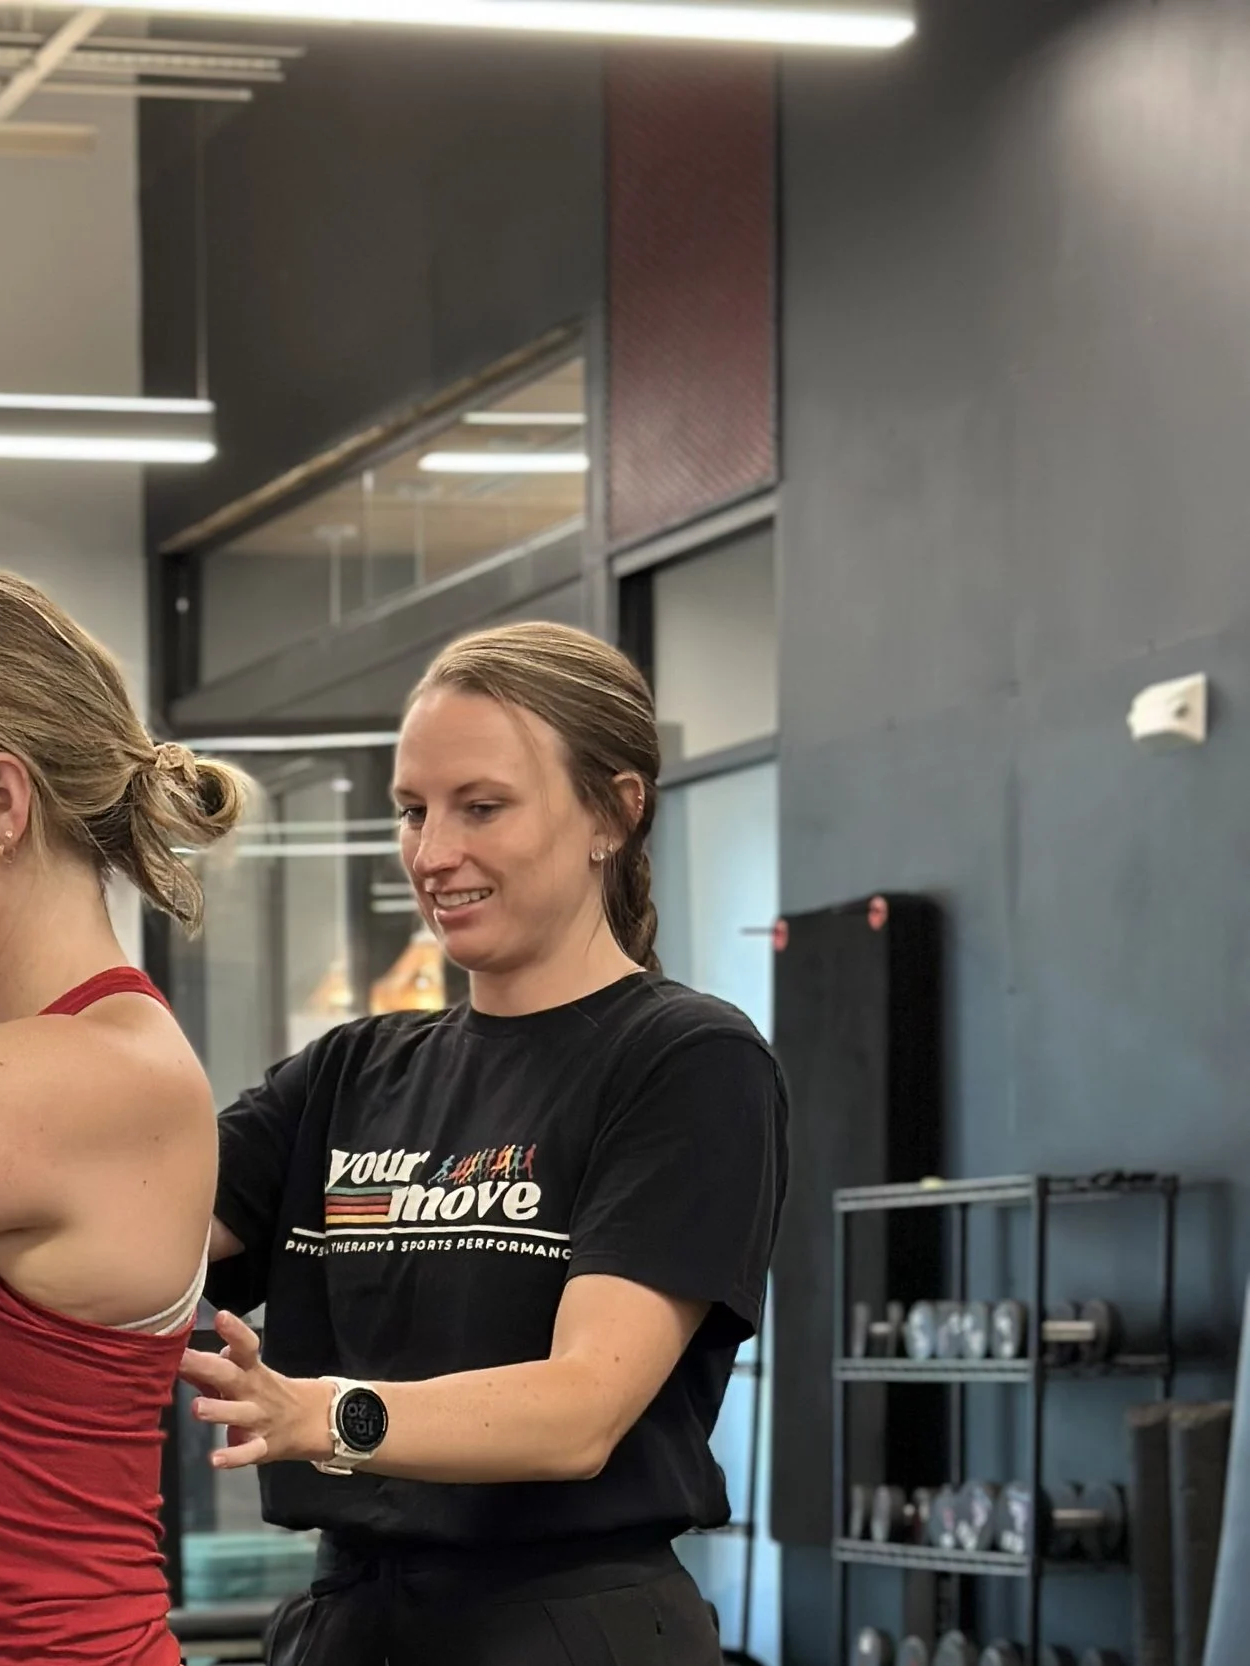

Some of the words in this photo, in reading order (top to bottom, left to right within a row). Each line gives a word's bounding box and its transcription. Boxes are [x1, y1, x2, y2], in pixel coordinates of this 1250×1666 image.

[325, 1149, 430, 1190] your
[387, 1181, 542, 1222] move
[401, 1239, 452, 1252] SPORTS
